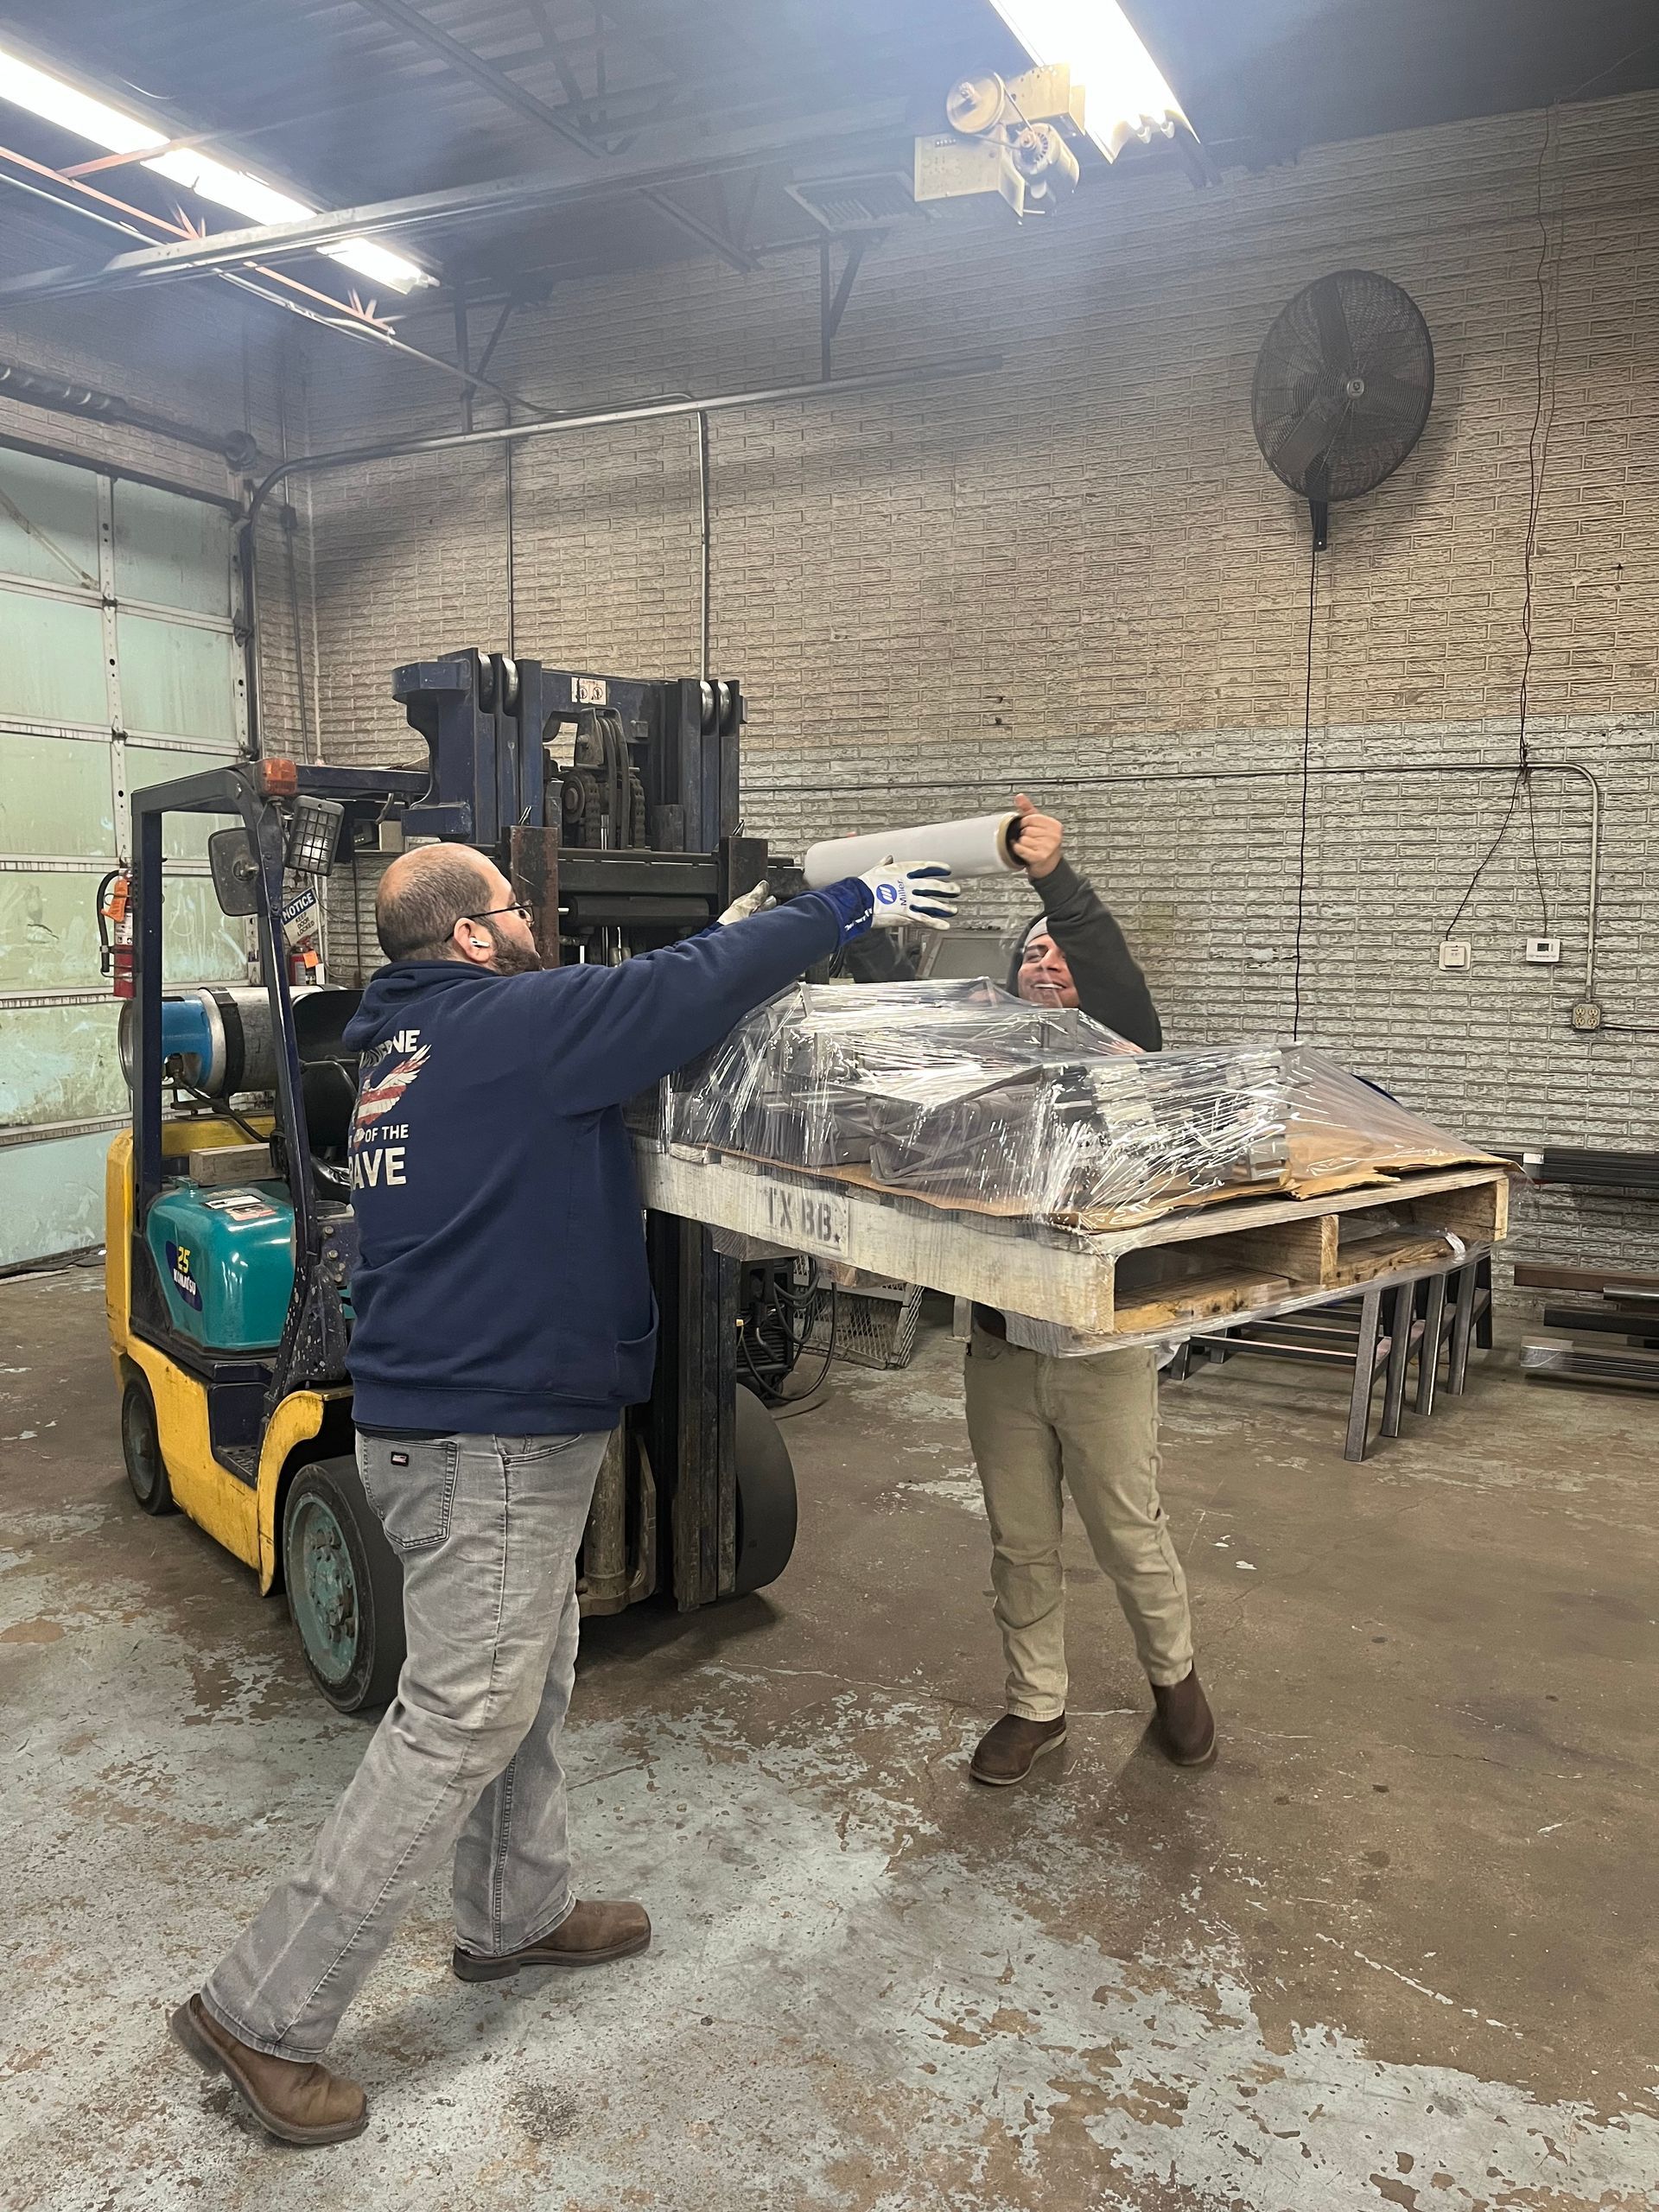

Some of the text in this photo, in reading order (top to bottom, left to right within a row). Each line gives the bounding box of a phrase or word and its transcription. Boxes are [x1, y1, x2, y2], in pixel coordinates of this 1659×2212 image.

[898, 880, 907, 906] Miller
[282, 893, 314, 921] NOTICE
[296, 912, 307, 922] KEEP
[297, 917, 310, 929] DOOR
[297, 920, 315, 936] LOCKED
[365, 1128, 378, 1142] OF
[381, 1124, 409, 1141] THE
[177, 1246, 191, 1274] 25
